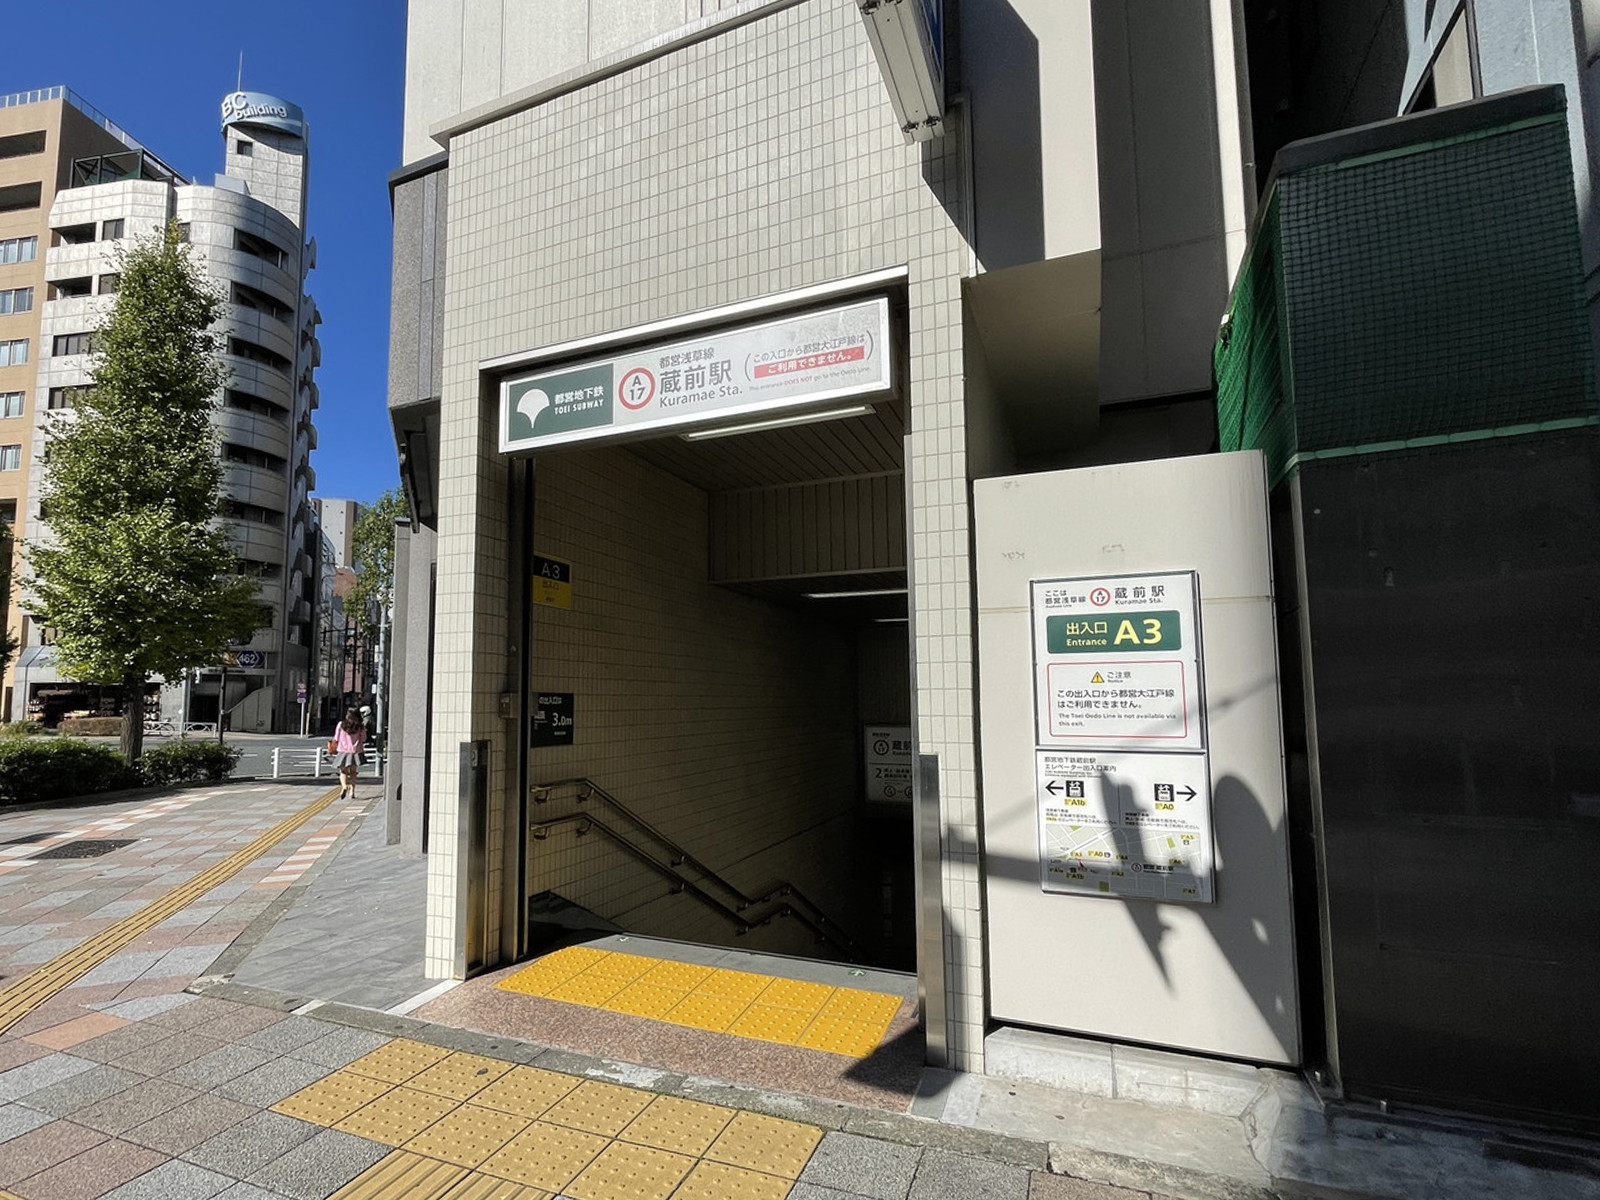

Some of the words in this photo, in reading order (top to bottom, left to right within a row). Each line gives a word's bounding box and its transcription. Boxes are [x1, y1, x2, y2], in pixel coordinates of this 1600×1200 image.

[222, 92, 248, 119] BC
[235, 104, 287, 120] building
[659, 347, 715, 368] 都営浅草線
[768, 354, 852, 374] ご利用できません。
[632, 375, 642, 386] A
[659, 359, 732, 395] 蔵前駅
[554, 386, 605, 407] 都営地下鉄
[629, 388, 646, 401] 17
[660, 390, 716, 408] Kuramae
[719, 385, 743, 399] Sta.
[554, 404, 571, 415] TOEI
[573, 399, 604, 412] SUBWAY
[541, 562, 561, 580] A3
[1115, 586, 1165, 599] 蔵前駅
[1066, 621, 1108, 635] 出入口
[1113, 618, 1162, 645] A3
[1066, 638, 1108, 647] Entrance
[239, 654, 256, 664] 462
[1107, 671, 1132, 679] ご注意
[1058, 689, 1175, 699] この出入口から都営大江戸線
[1058, 700, 1142, 709] はご利用できません。
[875, 768, 882, 779] 2
